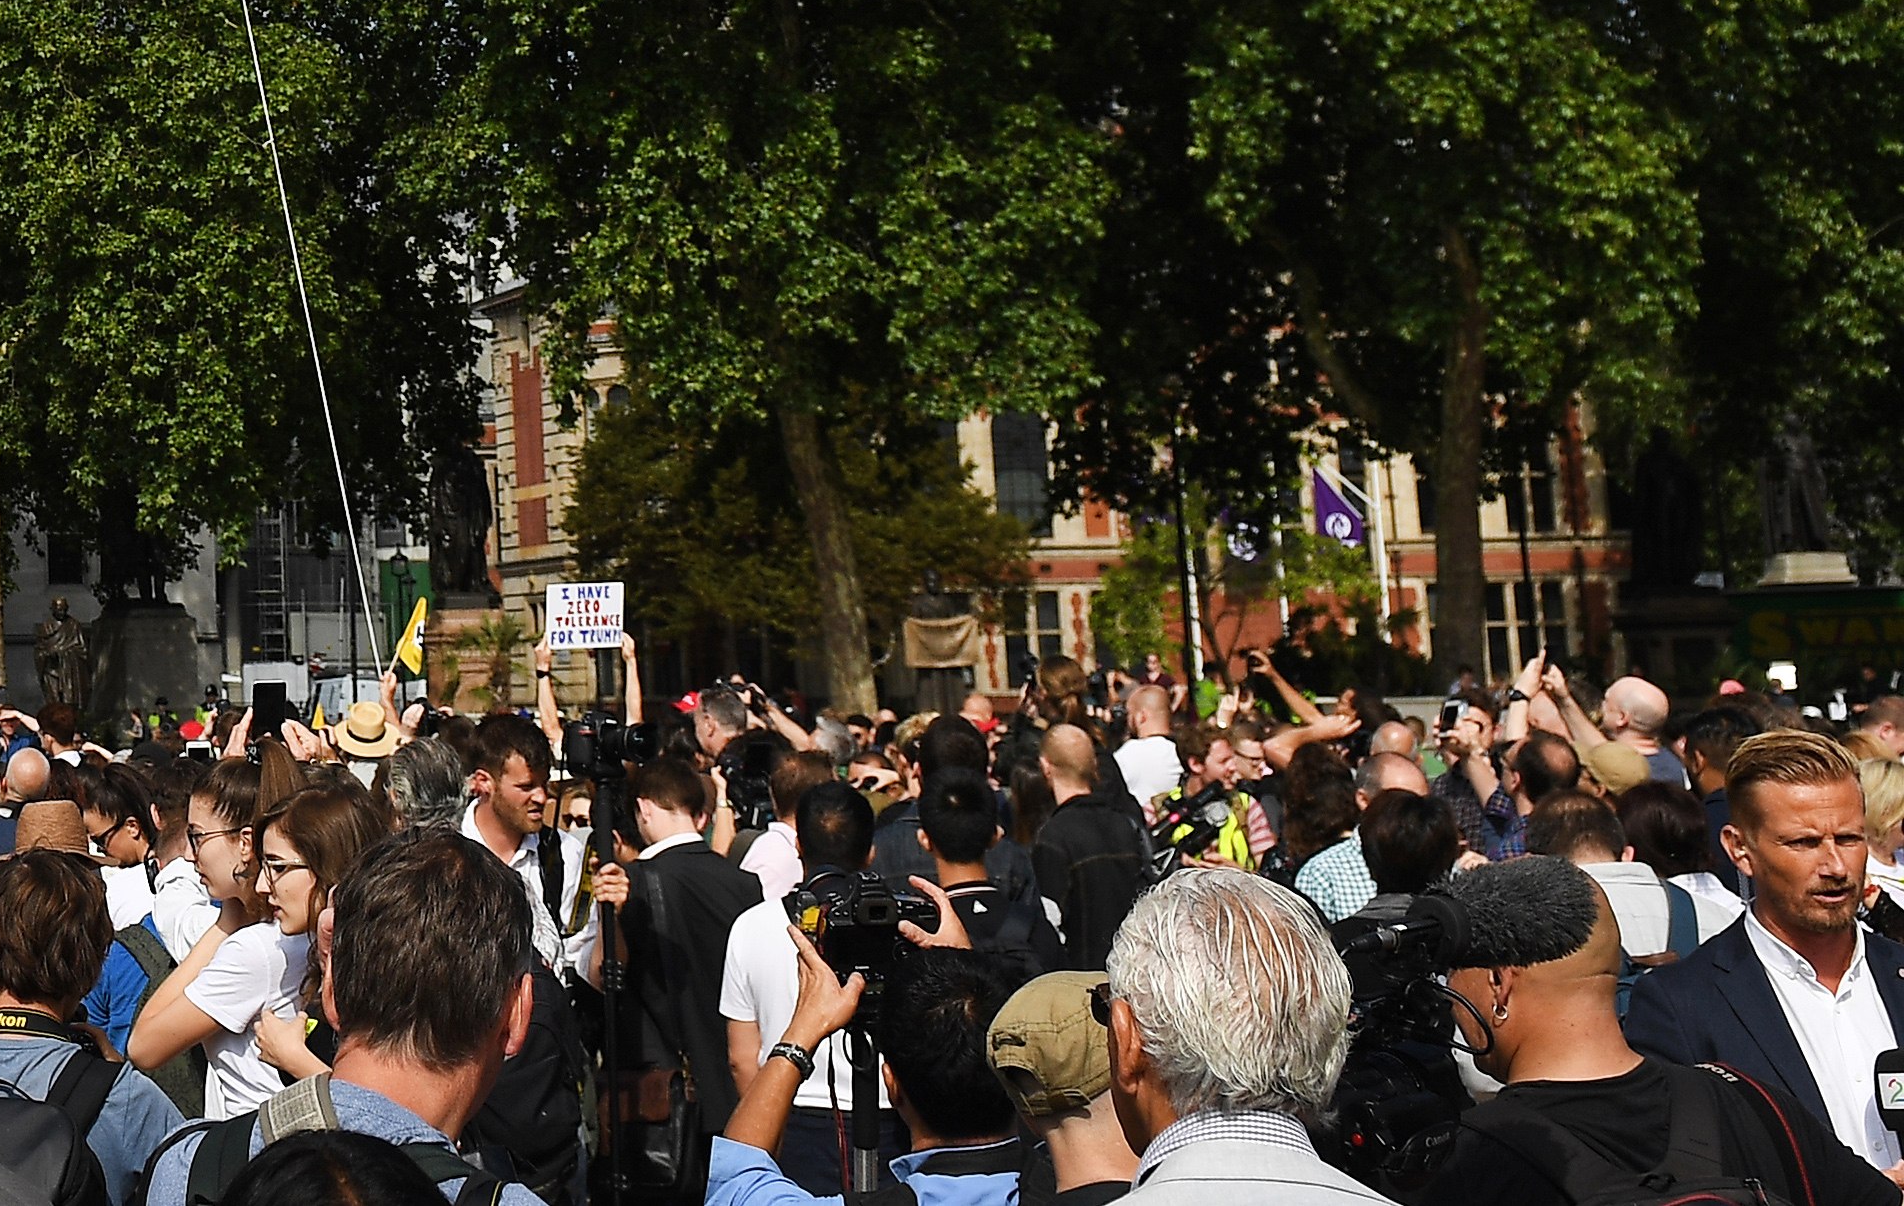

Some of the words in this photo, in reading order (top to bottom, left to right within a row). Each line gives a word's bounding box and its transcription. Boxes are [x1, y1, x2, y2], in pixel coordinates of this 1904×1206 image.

[562, 587, 569, 599] I
[578, 585, 610, 599] HAVE
[567, 599, 600, 615] ZERO
[555, 614, 620, 628] TOLERANCE
[551, 630, 574, 646] FOR
